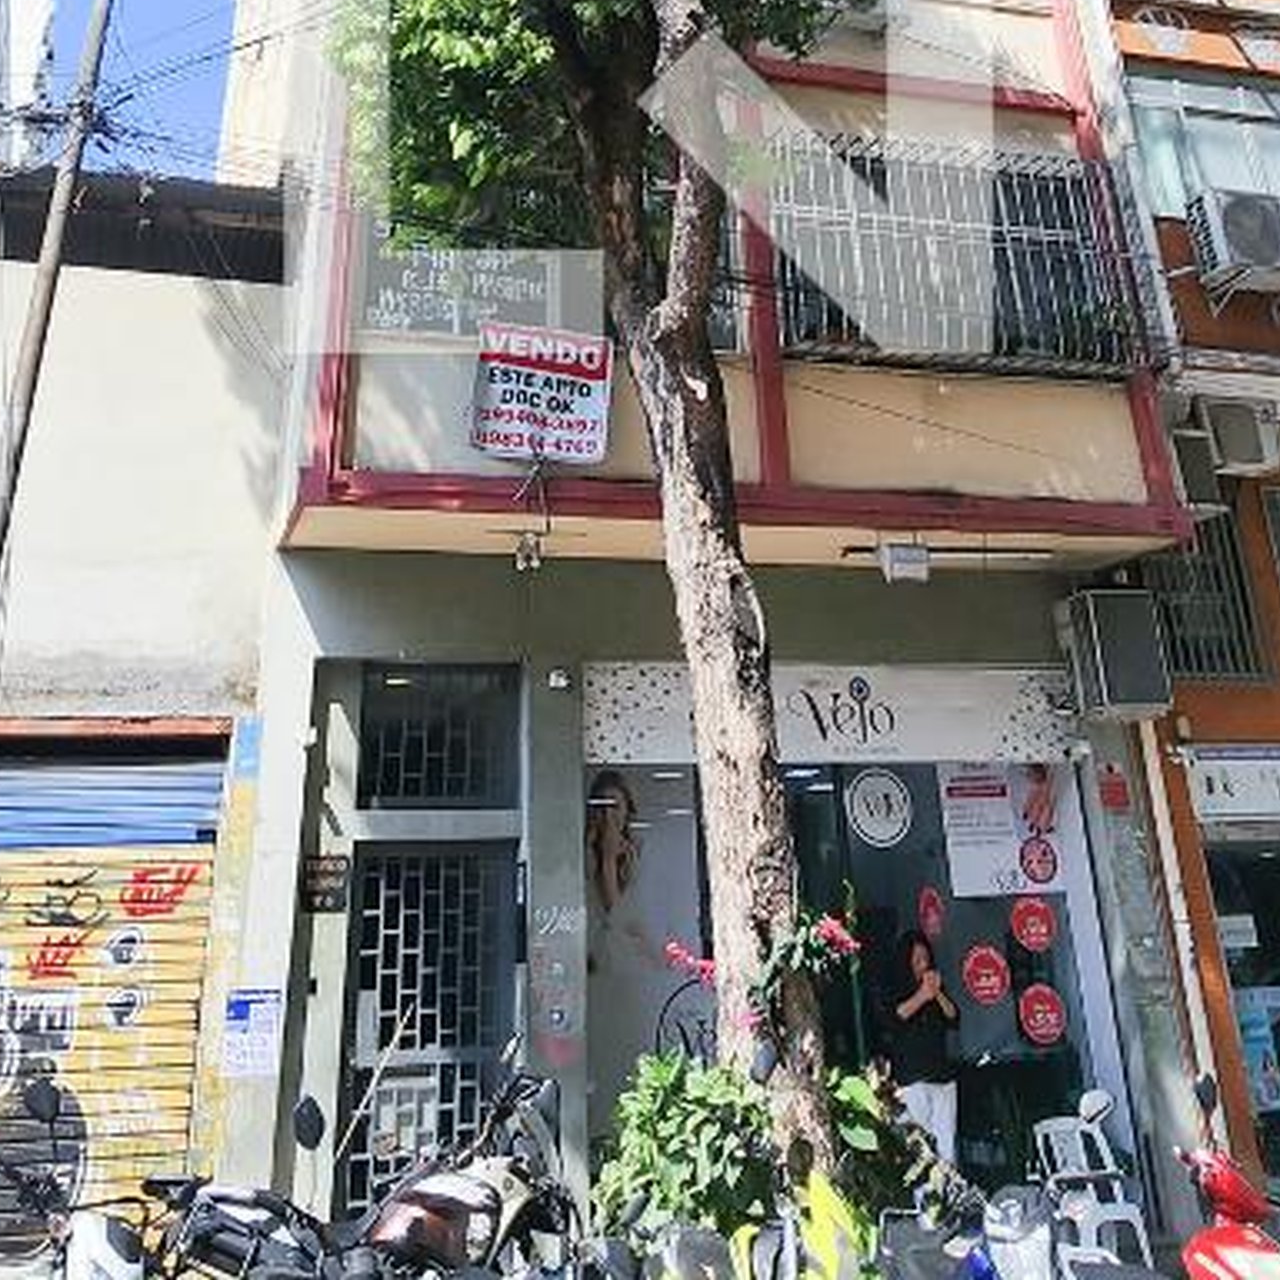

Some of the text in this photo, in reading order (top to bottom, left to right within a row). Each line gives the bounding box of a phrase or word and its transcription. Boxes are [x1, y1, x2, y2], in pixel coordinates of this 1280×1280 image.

[482, 330, 601, 370] VENDO
[488, 366, 592, 398] ESTE APTO
[500, 389, 576, 414] DOC OK
